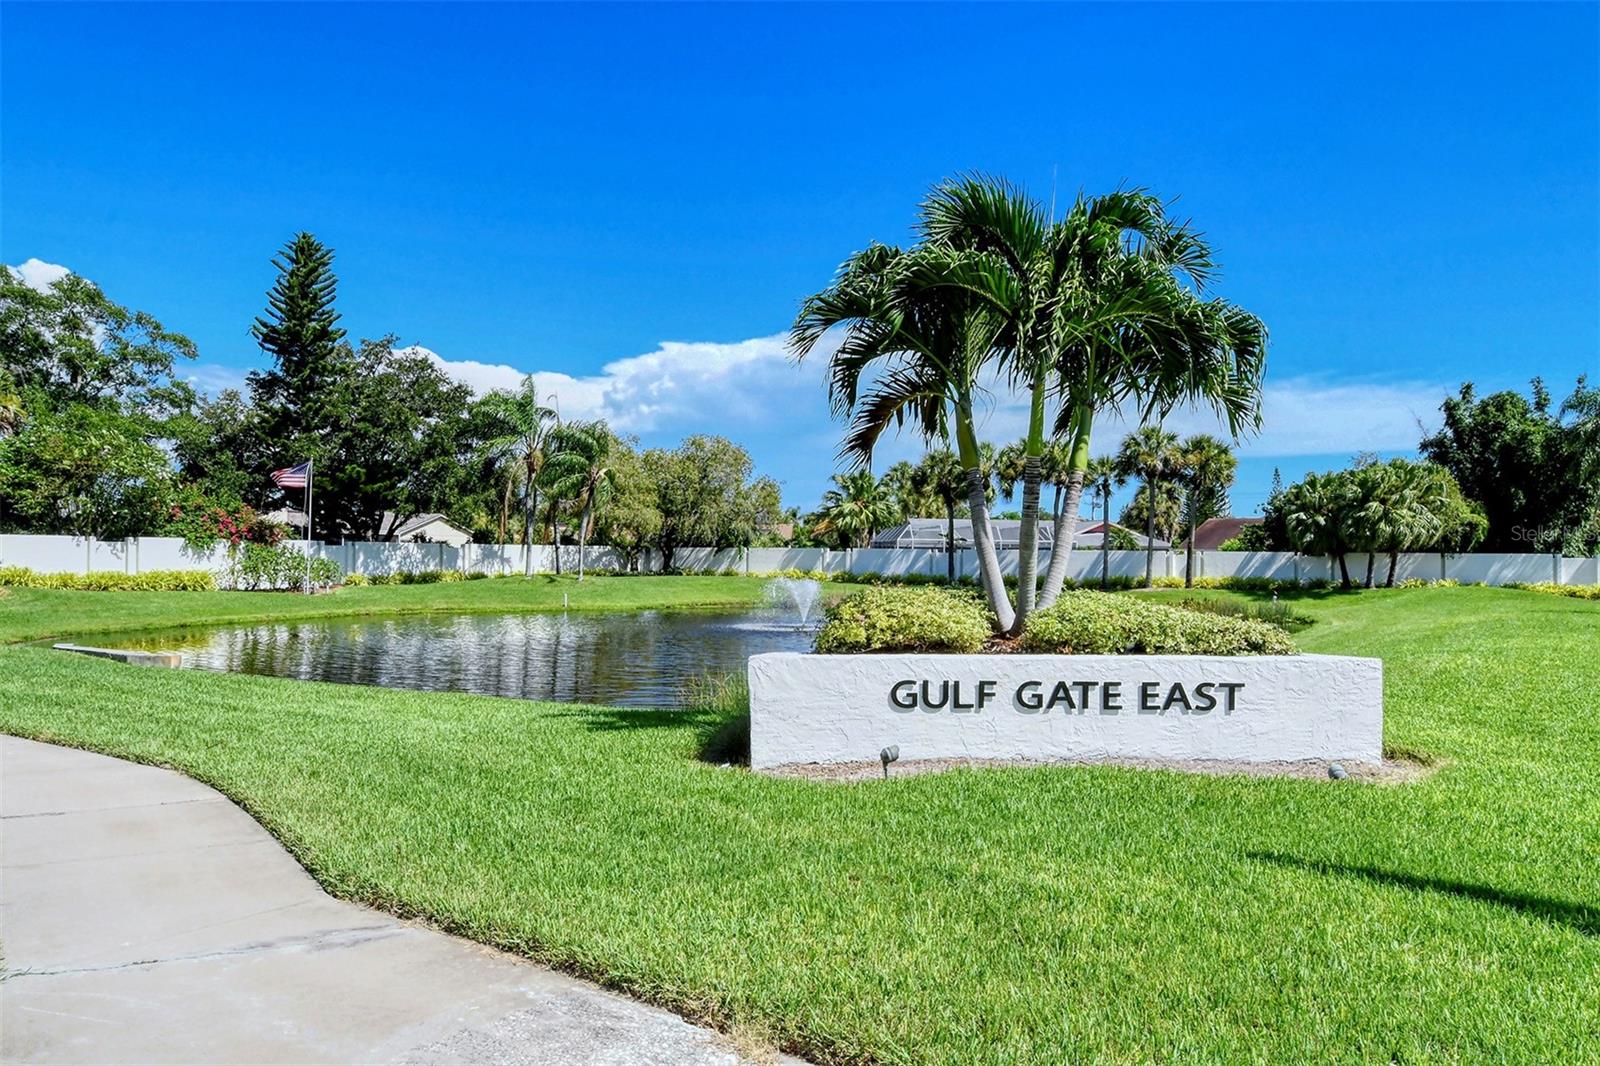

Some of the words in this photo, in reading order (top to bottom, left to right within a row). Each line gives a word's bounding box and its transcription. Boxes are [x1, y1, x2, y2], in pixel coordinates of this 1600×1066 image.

[890, 680, 997, 709] GULF
[1016, 680, 1123, 710] GATE
[1141, 682, 1245, 711] EAST
